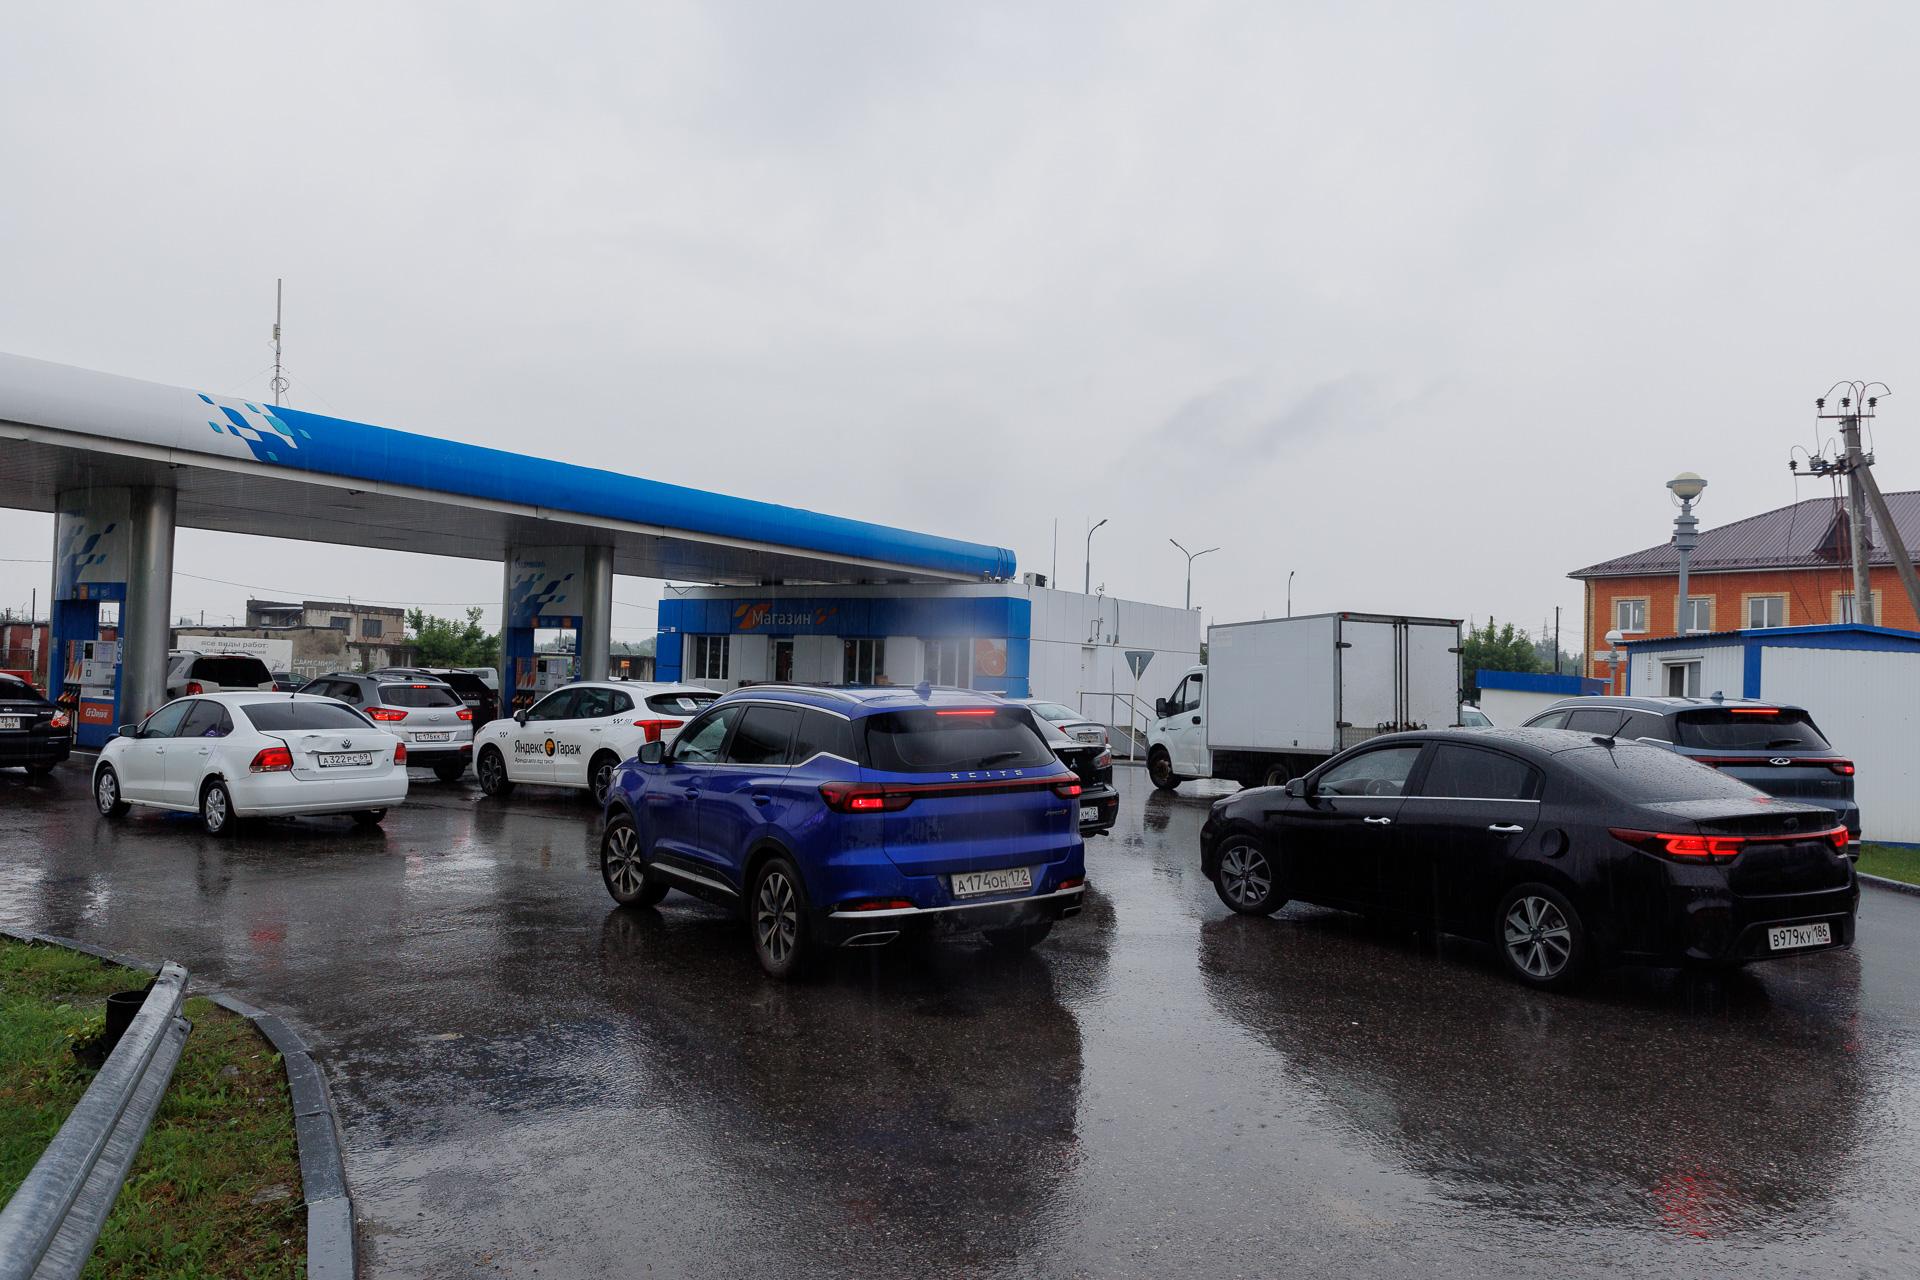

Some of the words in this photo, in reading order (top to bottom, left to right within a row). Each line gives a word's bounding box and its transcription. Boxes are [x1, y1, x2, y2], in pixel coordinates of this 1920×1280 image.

[752, 611, 811, 625] Магазин
[514, 740, 543, 755] Яндекс
[556, 741, 581, 756] Гараж
